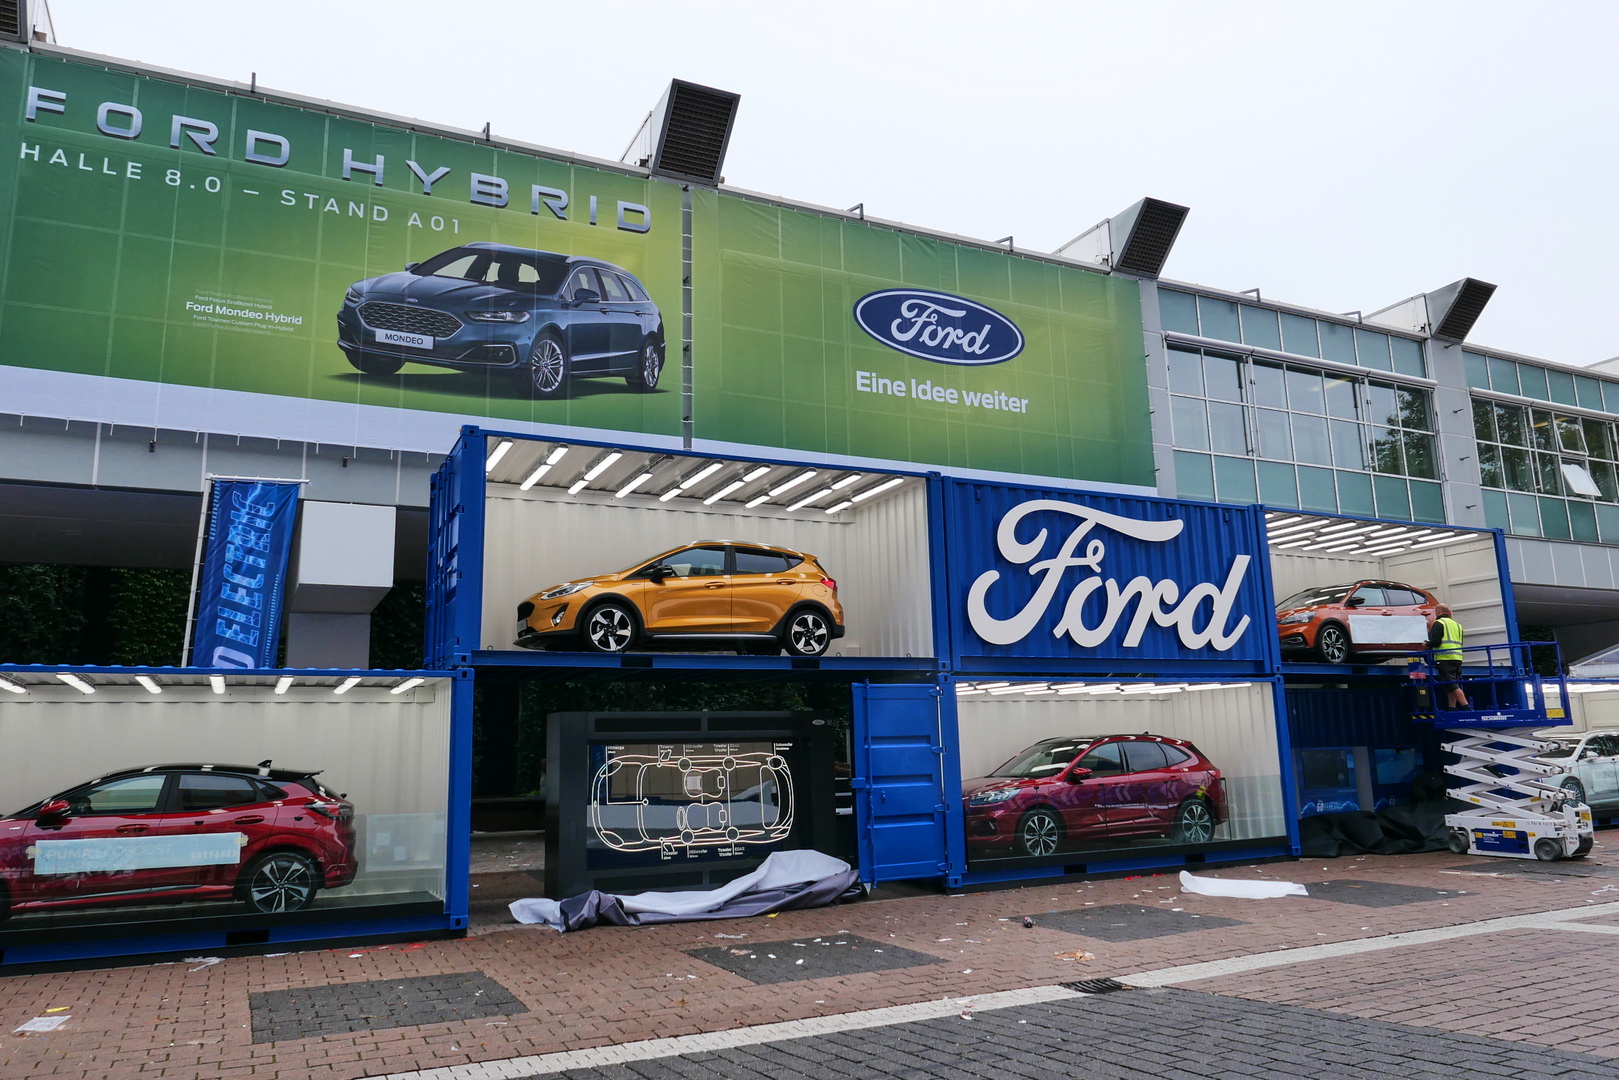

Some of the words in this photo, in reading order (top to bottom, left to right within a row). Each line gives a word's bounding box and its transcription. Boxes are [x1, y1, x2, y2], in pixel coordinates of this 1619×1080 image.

[20, 142, 143, 180] HALLE
[164, 169, 221, 193] 8.0
[280, 189, 389, 222] STAND
[407, 215, 460, 234] A01
[25, 86, 291, 167] FORD
[342, 147, 651, 234] HYBRID
[186, 301, 213, 314] Ford
[216, 305, 263, 319] Mondeo
[265, 312, 302, 325] Hybrid
[384, 333, 424, 345] MONDEO
[890, 299, 992, 355] Ford
[856, 370, 906, 397] Eine
[911, 378, 959, 405] Idee
[962, 390, 1029, 414] weiter
[215, 490, 276, 647] ELECTRIC
[967, 499, 1251, 652] Ford
